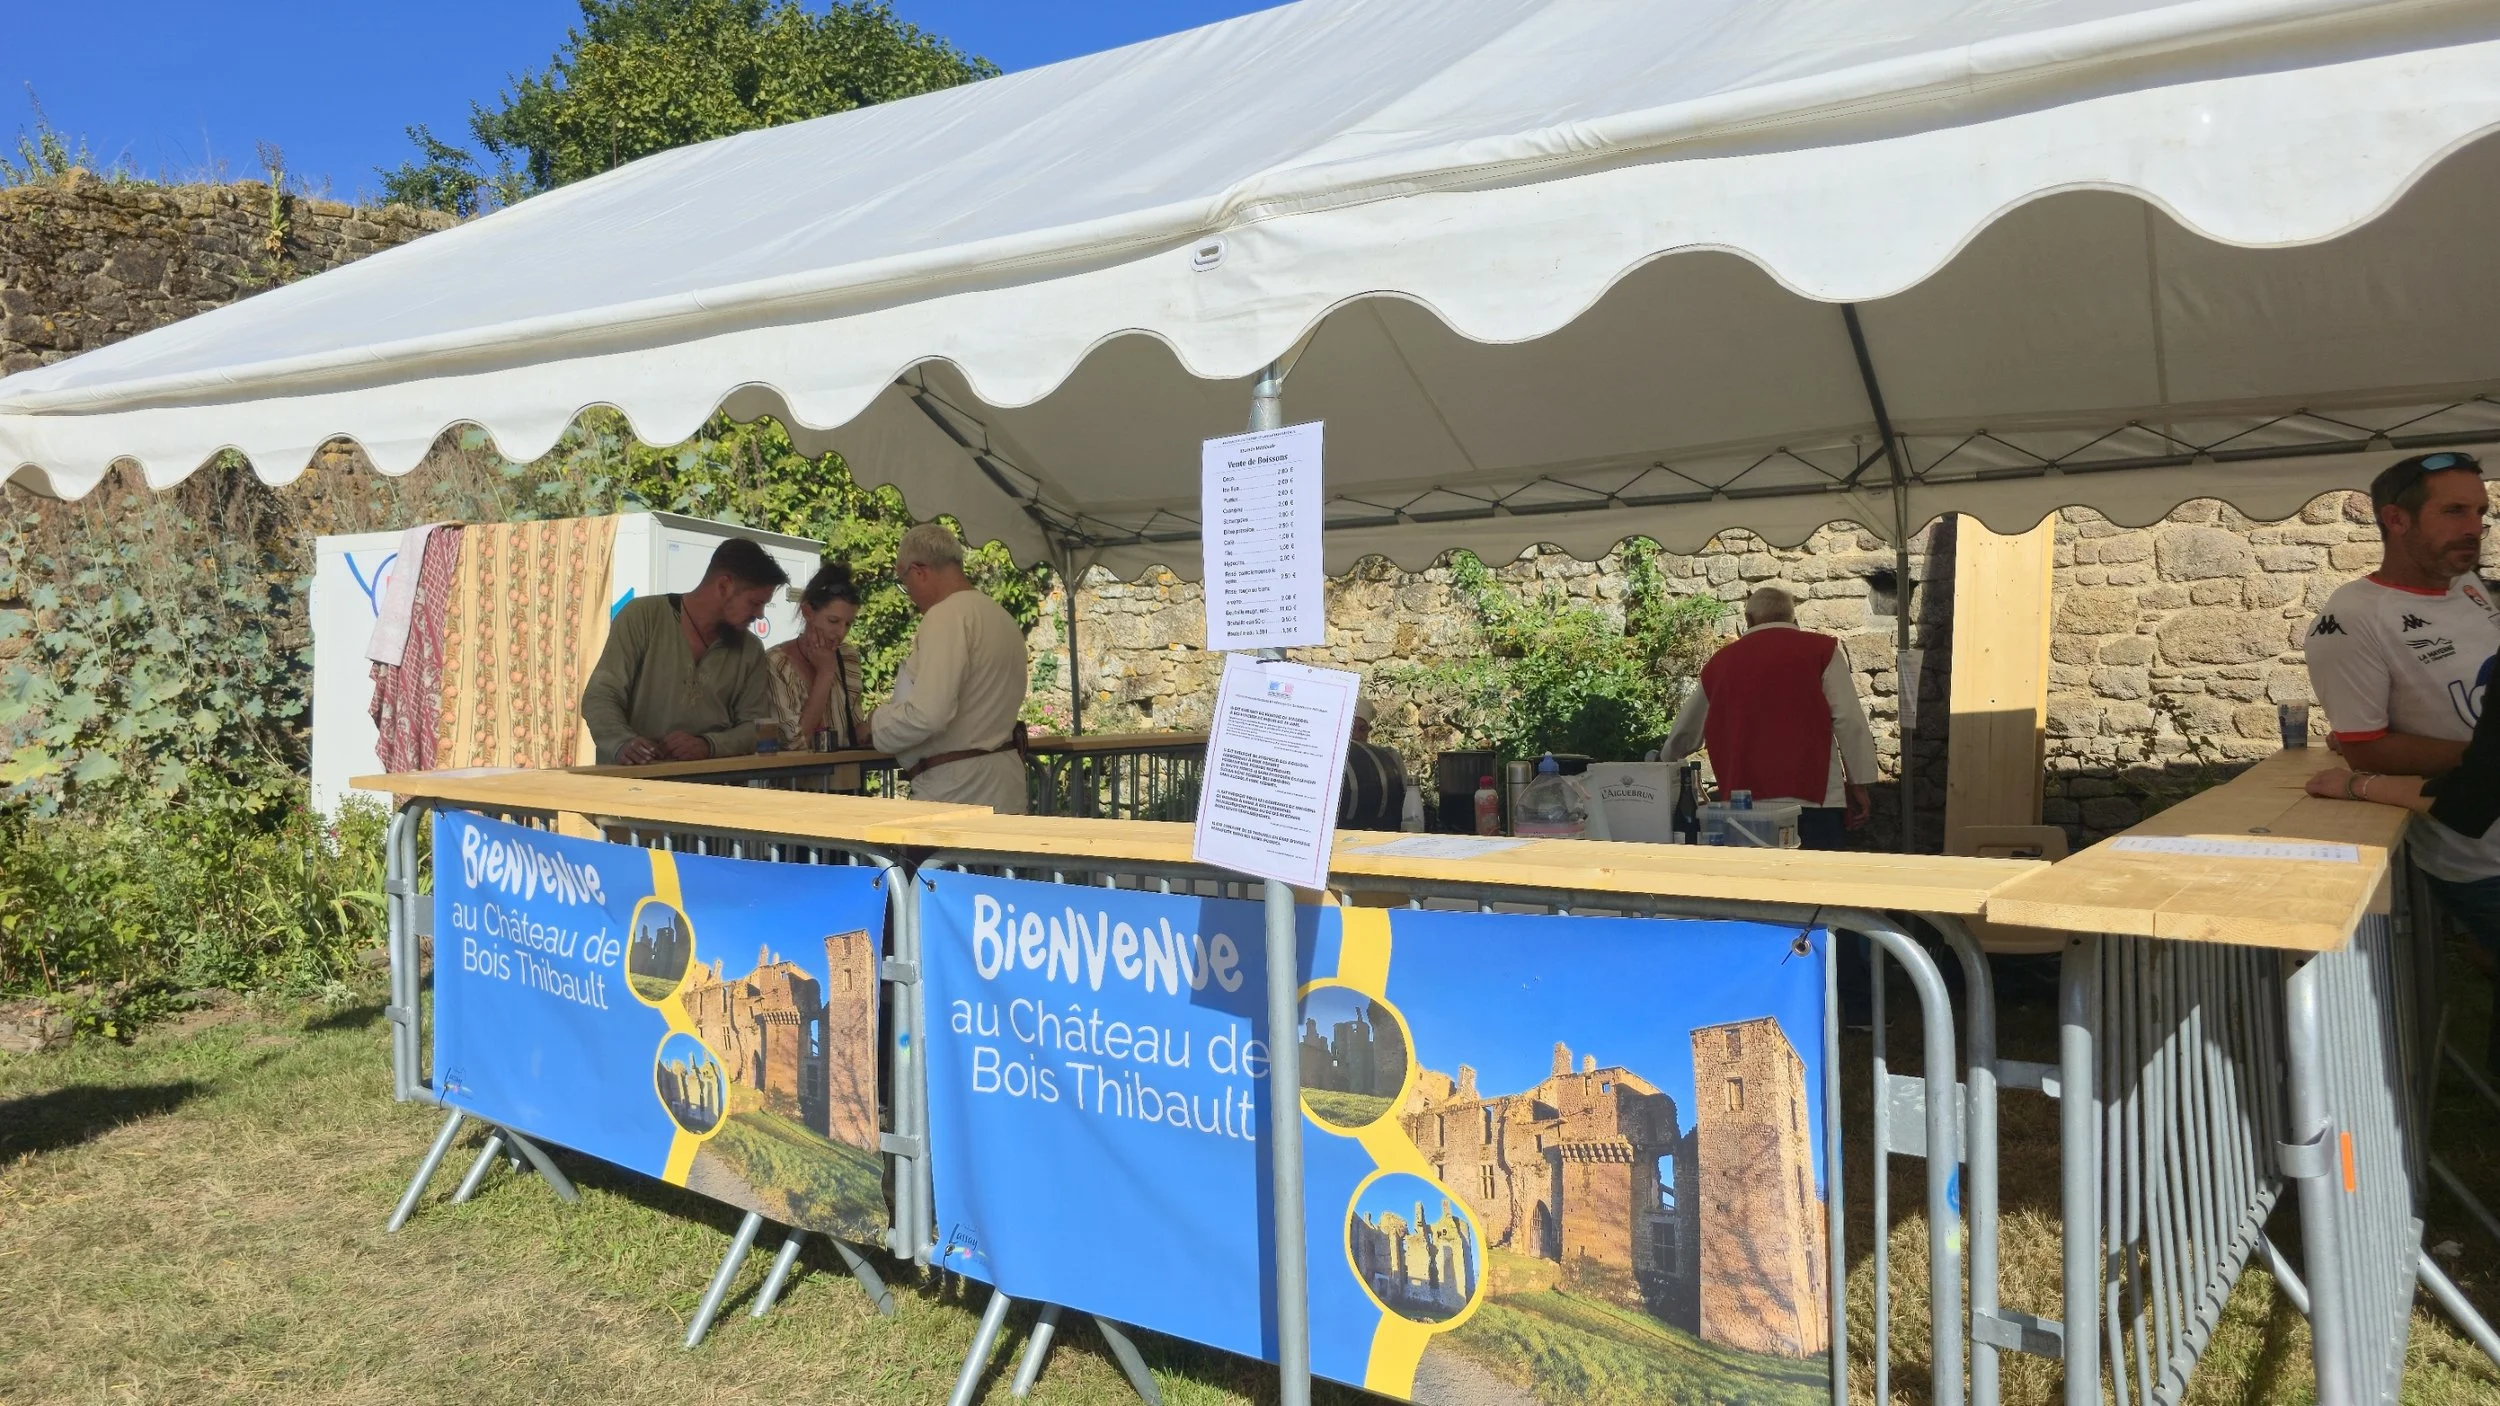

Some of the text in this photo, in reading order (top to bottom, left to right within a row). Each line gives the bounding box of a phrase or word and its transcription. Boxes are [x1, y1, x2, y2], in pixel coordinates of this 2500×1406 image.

[1228, 454, 1288, 468] Vente de Boissons
[452, 902, 620, 968] au Château de
[464, 937, 608, 1010] Bois Thibault
[952, 998, 1271, 1079] au Château de
[973, 1046, 1256, 1141] Bois Thibault
